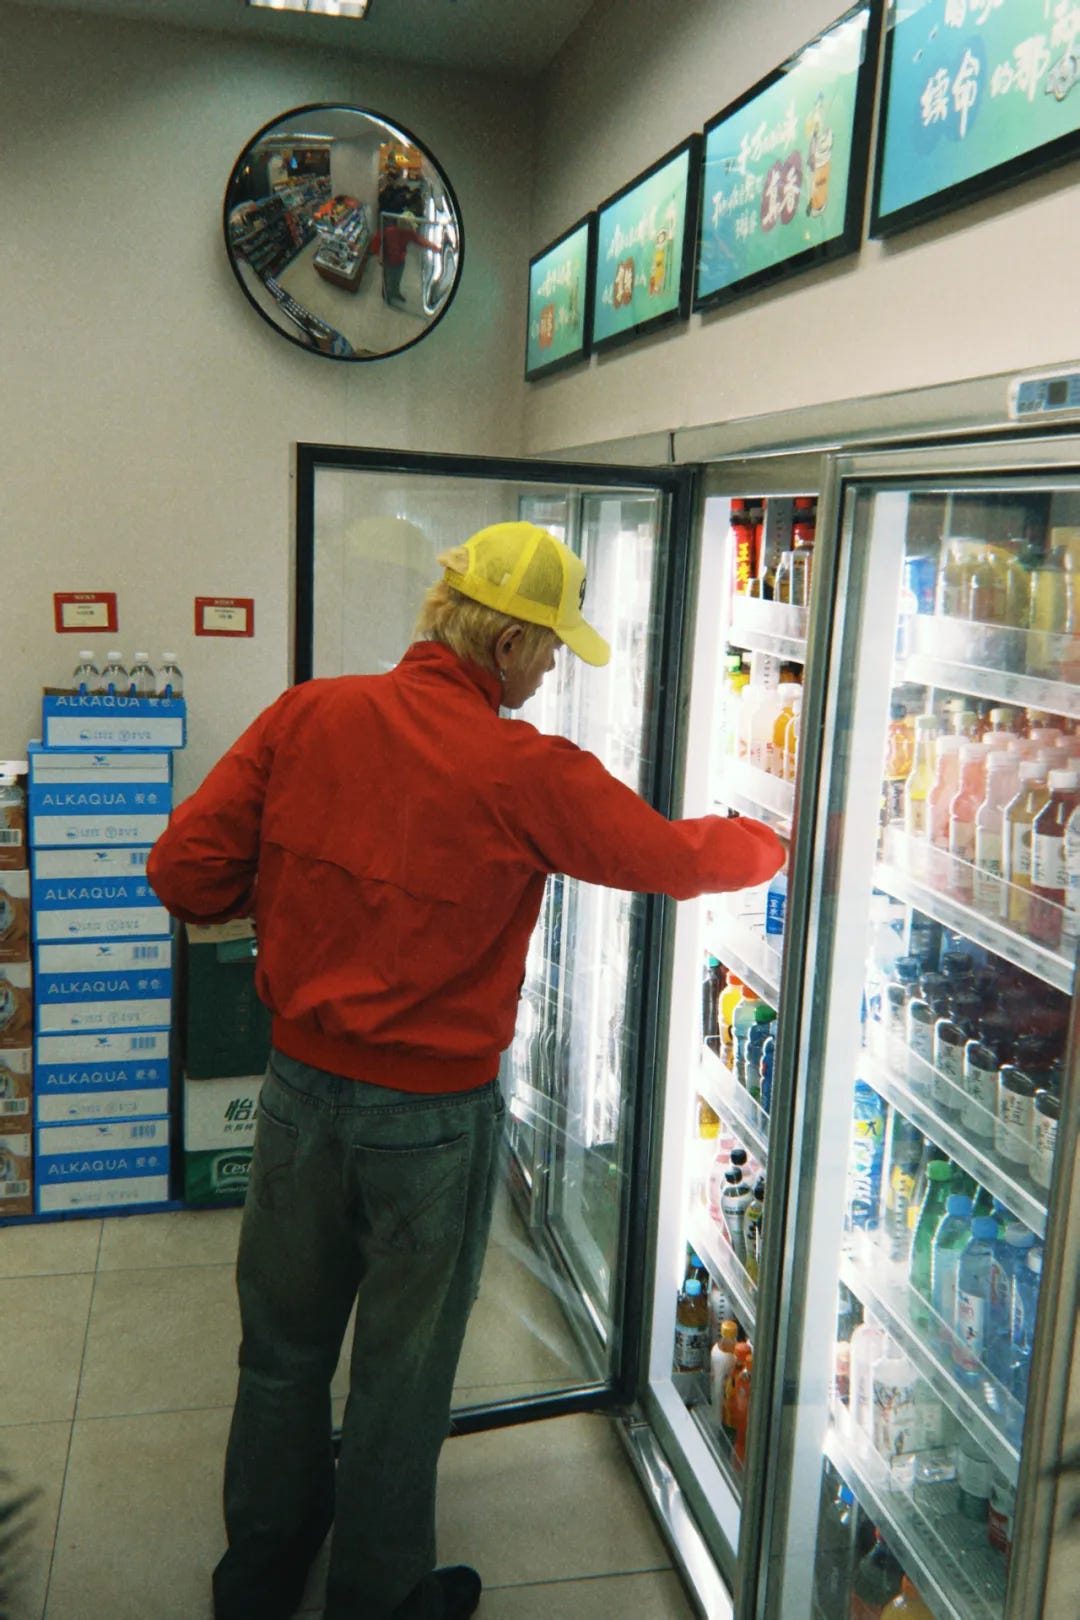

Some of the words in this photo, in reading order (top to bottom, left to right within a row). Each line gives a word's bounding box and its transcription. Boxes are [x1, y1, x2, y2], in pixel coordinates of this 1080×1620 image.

[56, 696, 140, 707] ALKAQUA
[42, 794, 127, 806] ALKAQUA
[44, 887, 127, 900] ALKAQUA
[48, 981, 130, 994] ALKAQUA
[47, 1071, 128, 1085] ALKAQUA
[224, 1098, 256, 1121] 怡
[48, 1159, 128, 1175] ALKAQUA
